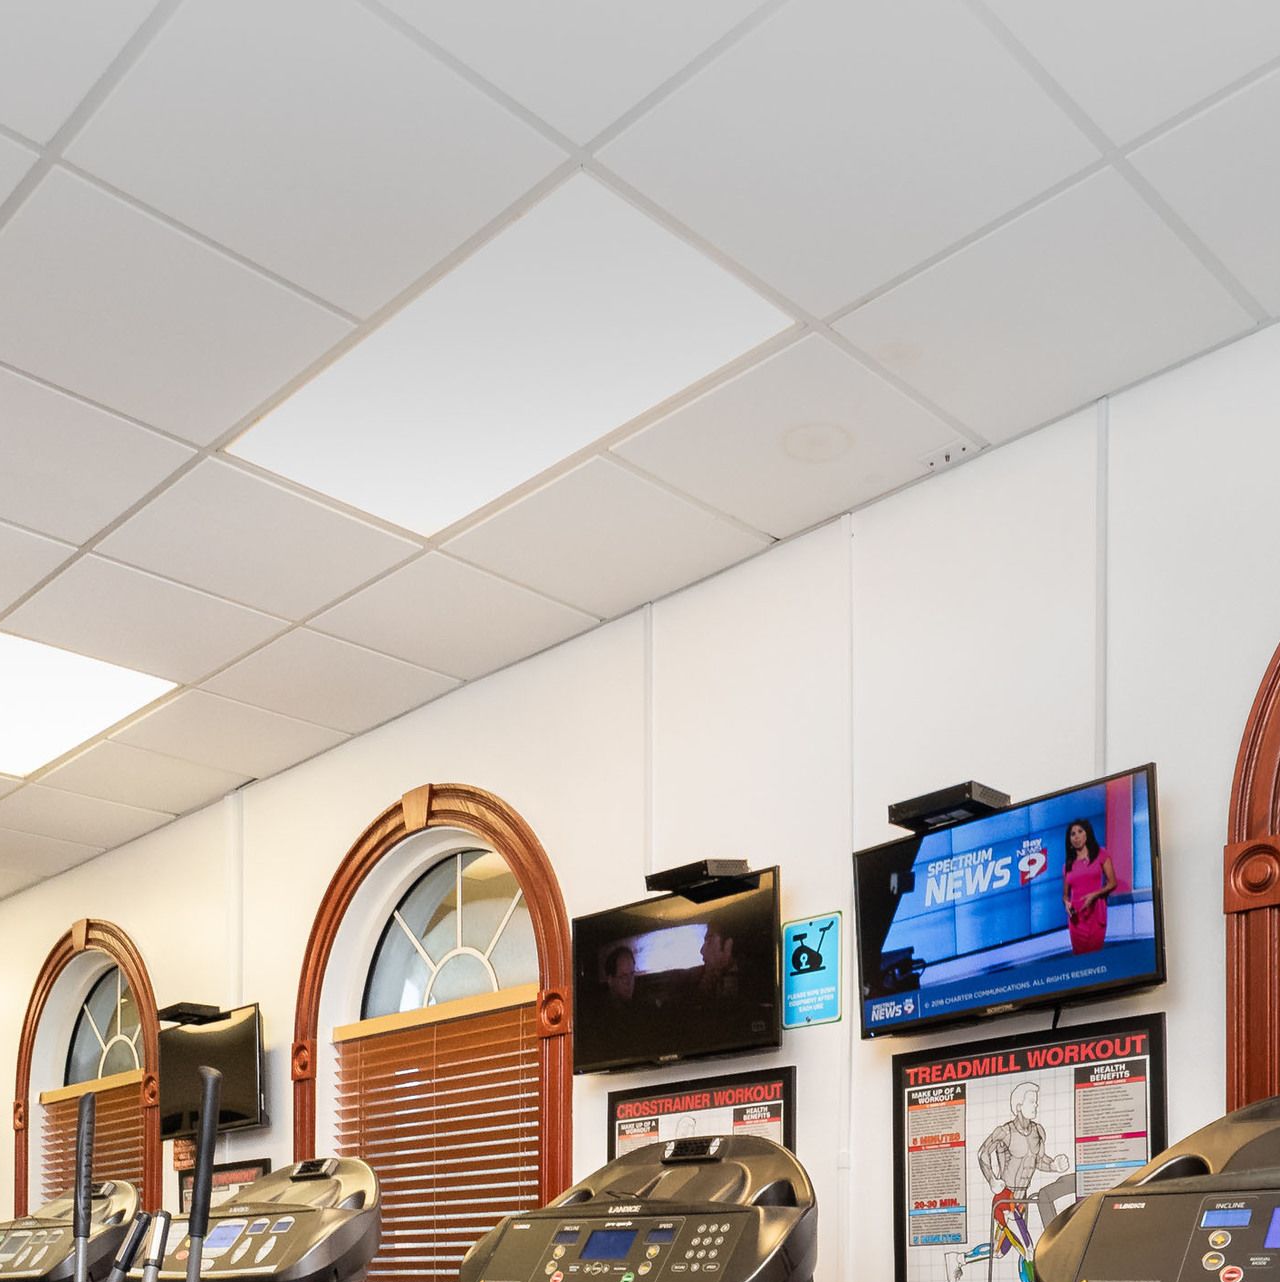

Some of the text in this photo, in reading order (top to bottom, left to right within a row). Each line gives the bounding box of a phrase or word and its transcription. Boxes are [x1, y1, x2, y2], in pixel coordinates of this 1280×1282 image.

[927, 848, 993, 878] SPECTRUM
[1018, 852, 1046, 880] 9
[925, 856, 1012, 907] NEWS
[945, 993, 973, 1005] CHARTER
[1033, 977, 1045, 987] ALL
[1046, 972, 1070, 984] RIGHTS
[871, 1005, 903, 1022] NEWS
[906, 1034, 1147, 1086] TREADMILL WORKOUT
[1094, 1063, 1126, 1075] HEALTH
[1090, 1070, 1130, 1083] BENEFITS
[912, 1086, 962, 1100] MAKE UP OF A
[918, 1094, 955, 1105] WORKOUT
[616, 1082, 784, 1119] CROSSTRAINER WORKOUT
[743, 1112, 771, 1121] BENEFITS
[746, 1106, 769, 1114] HEALTH
[920, 1132, 961, 1146] MINUTES
[608, 1205, 642, 1214] LANDICE
[914, 1198, 960, 1209] 20-30 MIN.
